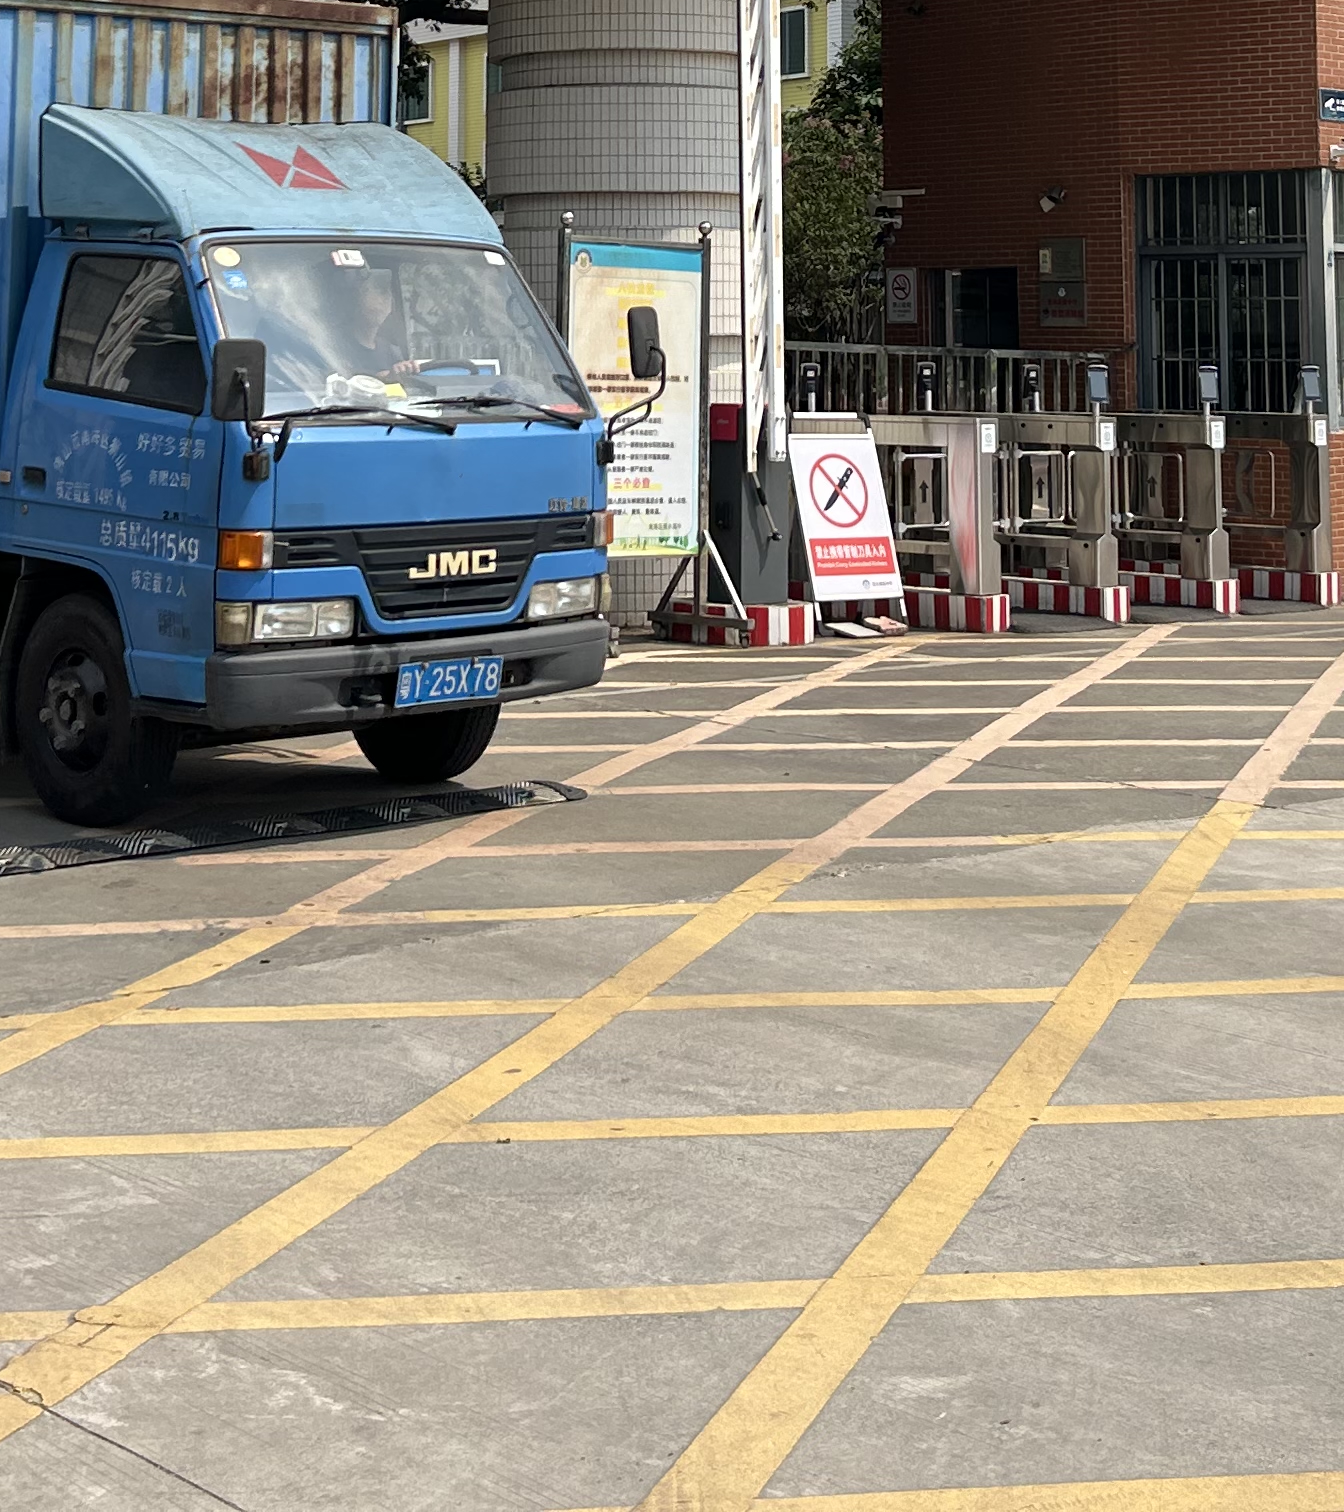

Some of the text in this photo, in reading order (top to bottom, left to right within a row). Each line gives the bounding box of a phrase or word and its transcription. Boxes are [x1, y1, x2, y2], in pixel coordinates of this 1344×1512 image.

[136, 432, 206, 460] 好好多贸易
[148, 468, 192, 491] 有限公司
[408, 548, 498, 580] JMC
